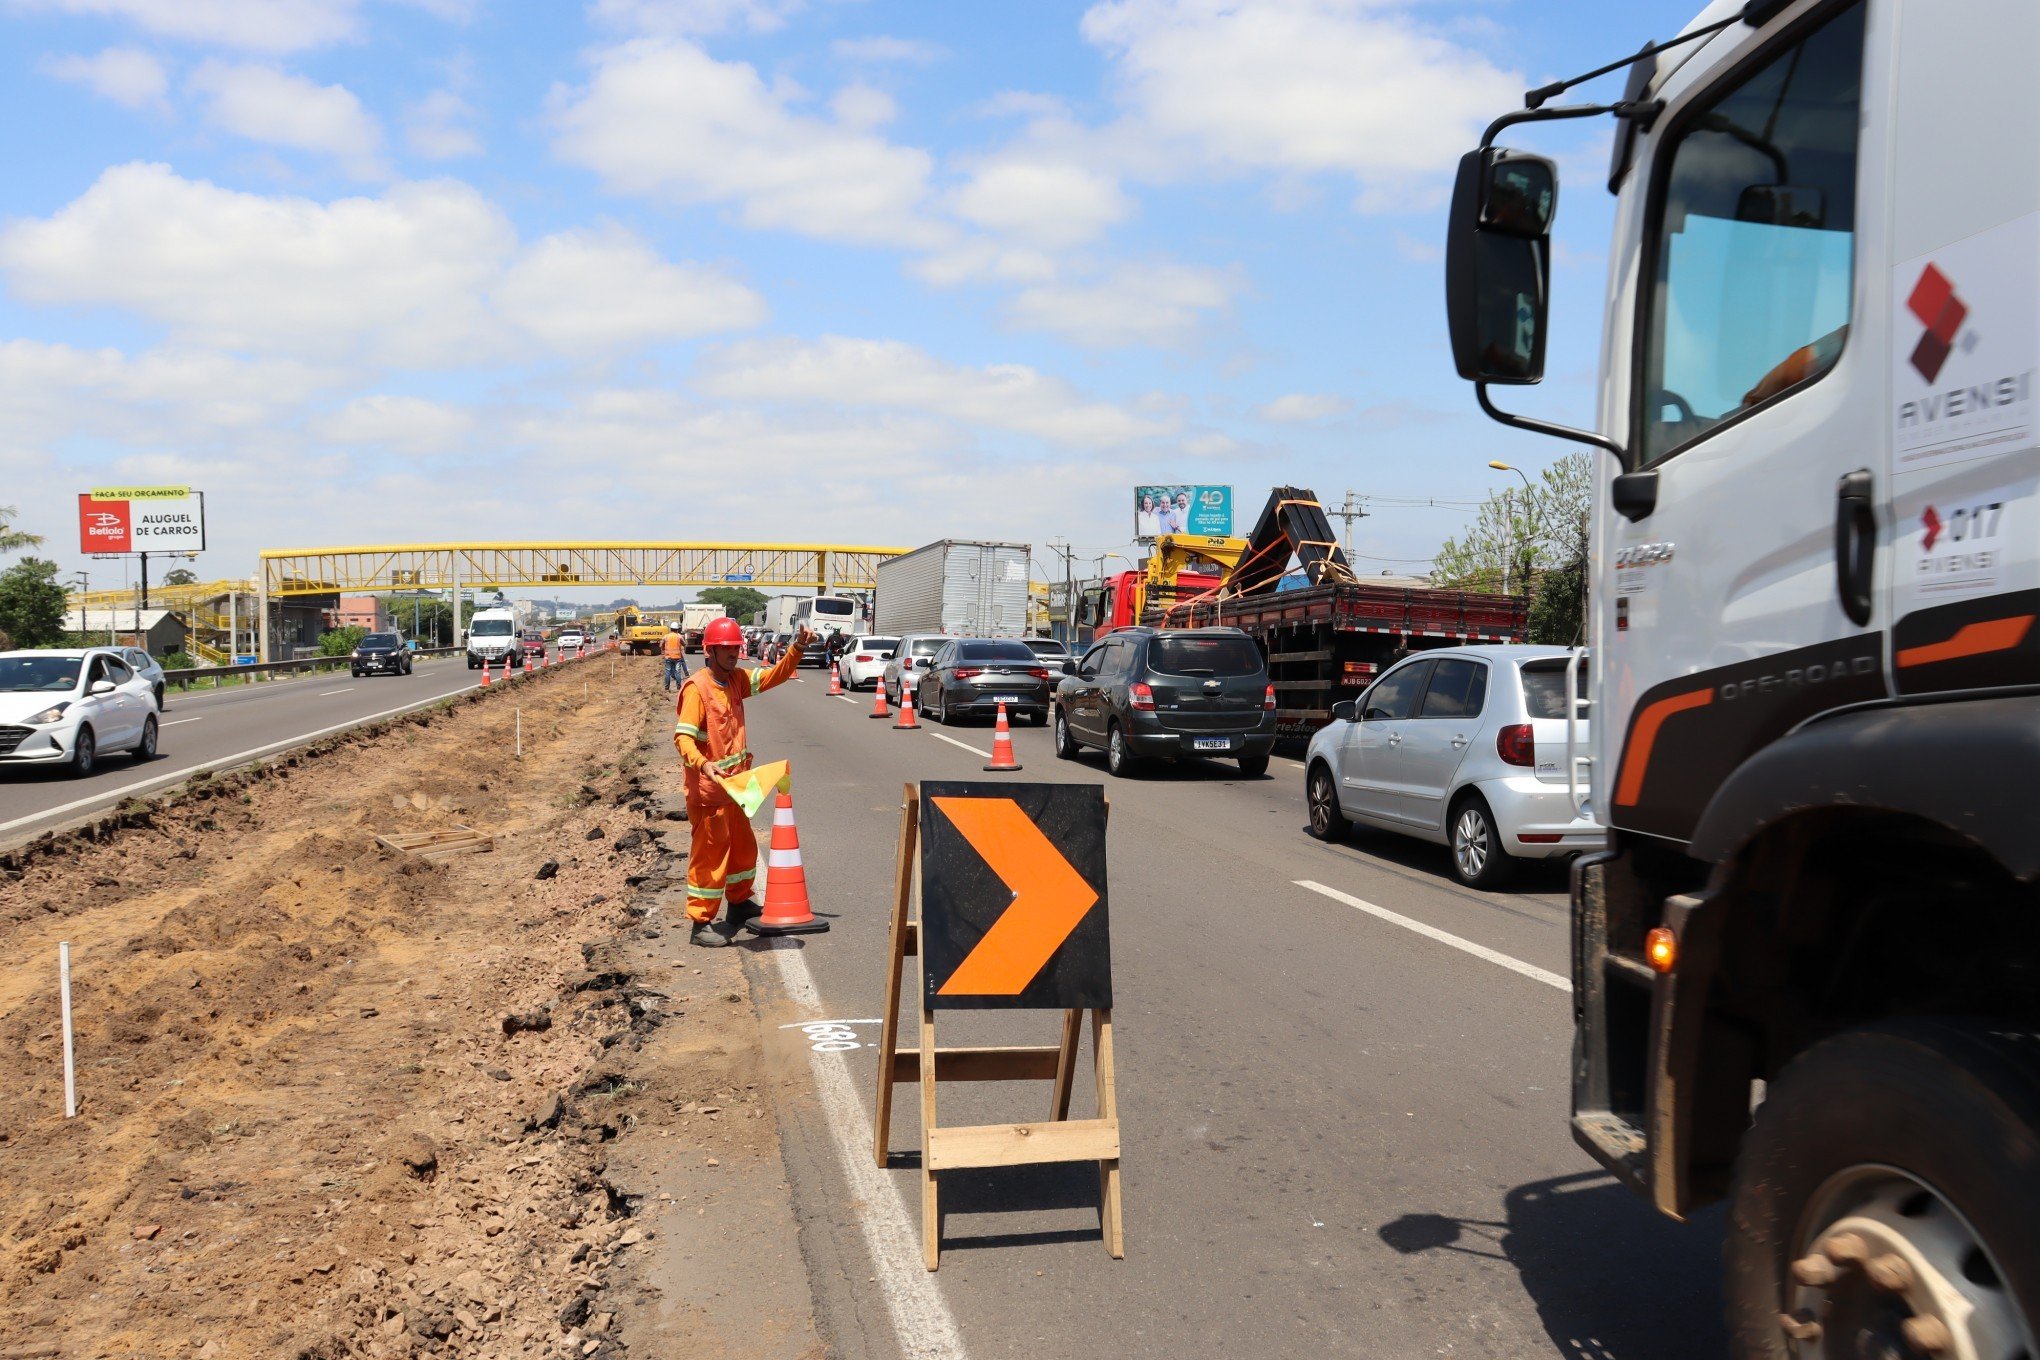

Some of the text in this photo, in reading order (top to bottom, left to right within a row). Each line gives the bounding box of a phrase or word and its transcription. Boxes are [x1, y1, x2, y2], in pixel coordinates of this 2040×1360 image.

[1199, 491, 1223, 505] 40
[142, 514, 191, 523] ALUGUEL
[1949, 502, 2004, 543] 017
[89, 527, 124, 535] Betiolo
[136, 526, 198, 535] DE CARROS
[1720, 656, 1876, 700] OFF-ROAD
